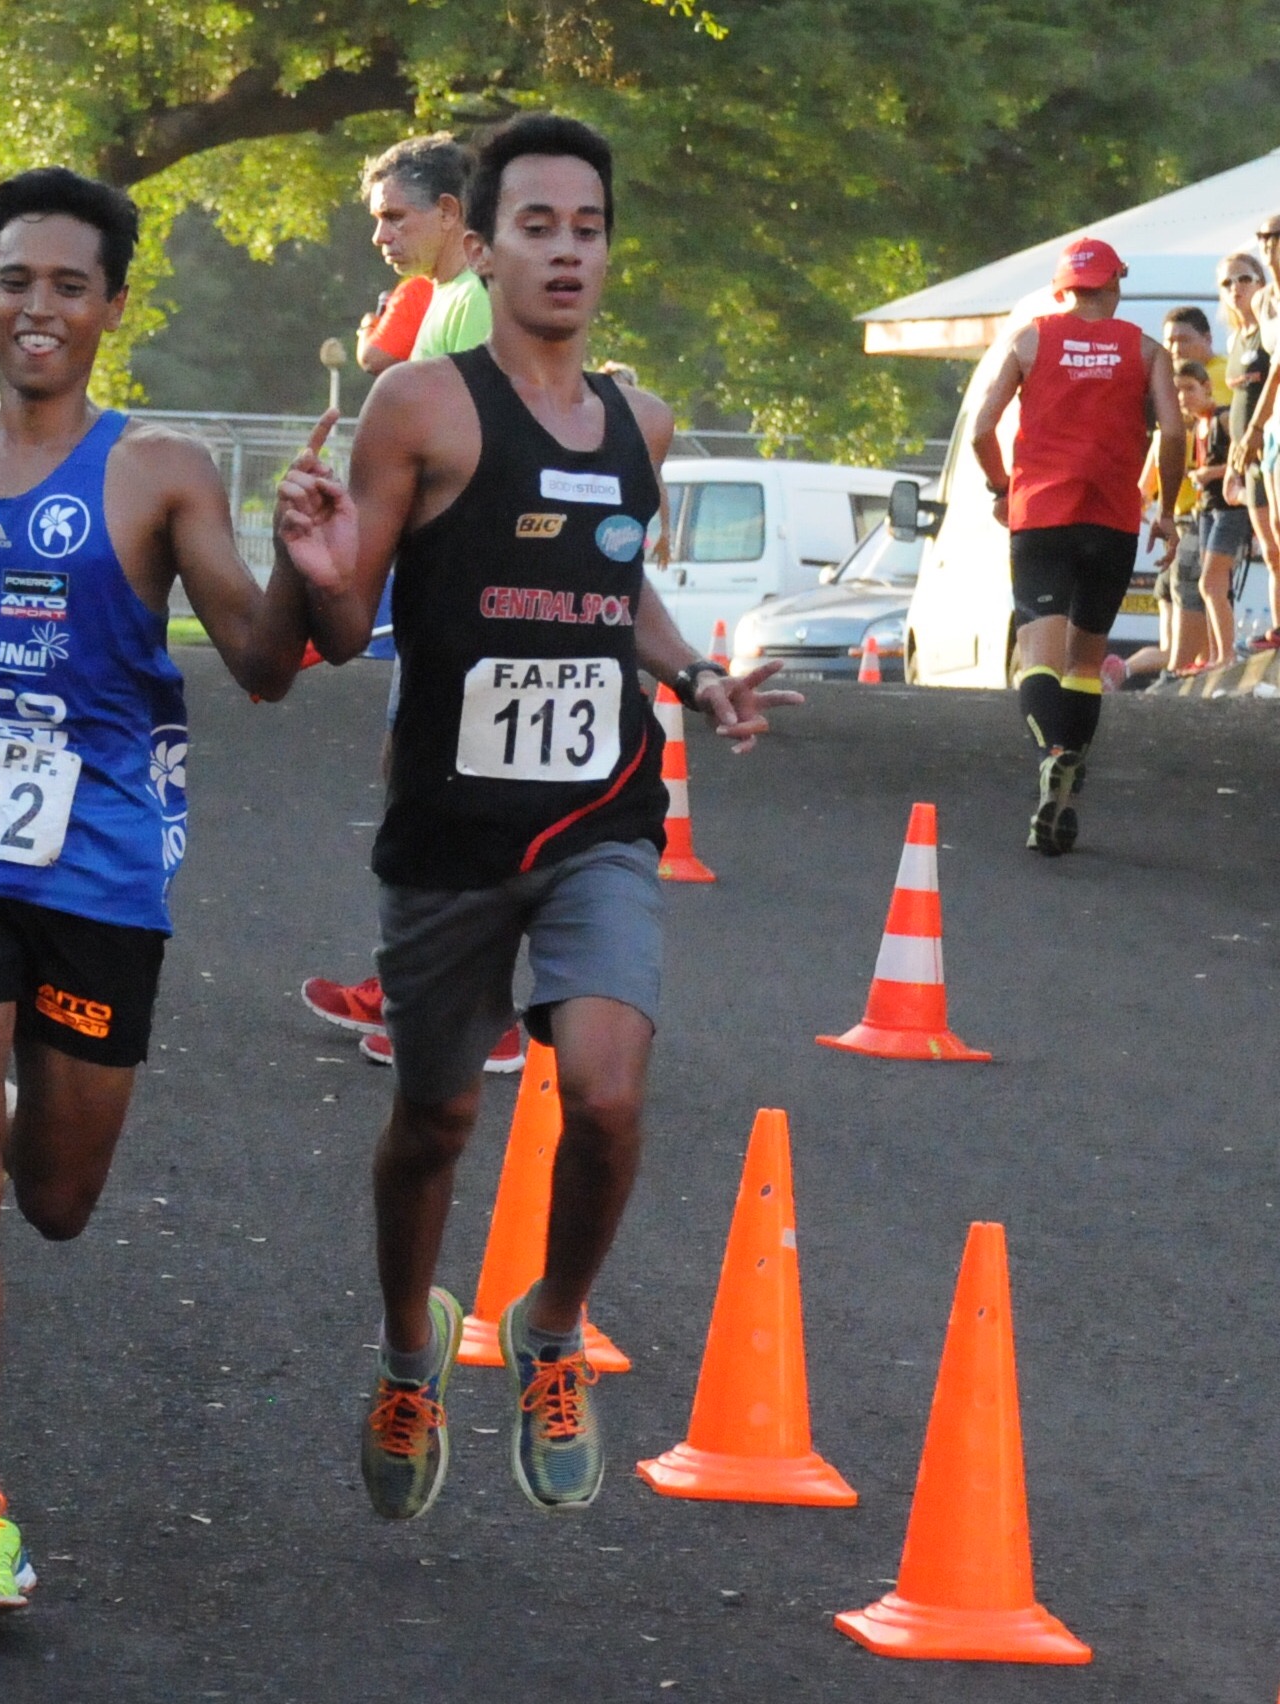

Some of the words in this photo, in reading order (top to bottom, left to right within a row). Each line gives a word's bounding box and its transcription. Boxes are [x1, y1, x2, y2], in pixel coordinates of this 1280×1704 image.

[1059, 353, 1121, 367] ASCEP
[0, 607, 67, 620] SPORT
[480, 586, 578, 625] CENTRAL
[493, 698, 596, 767] 113
